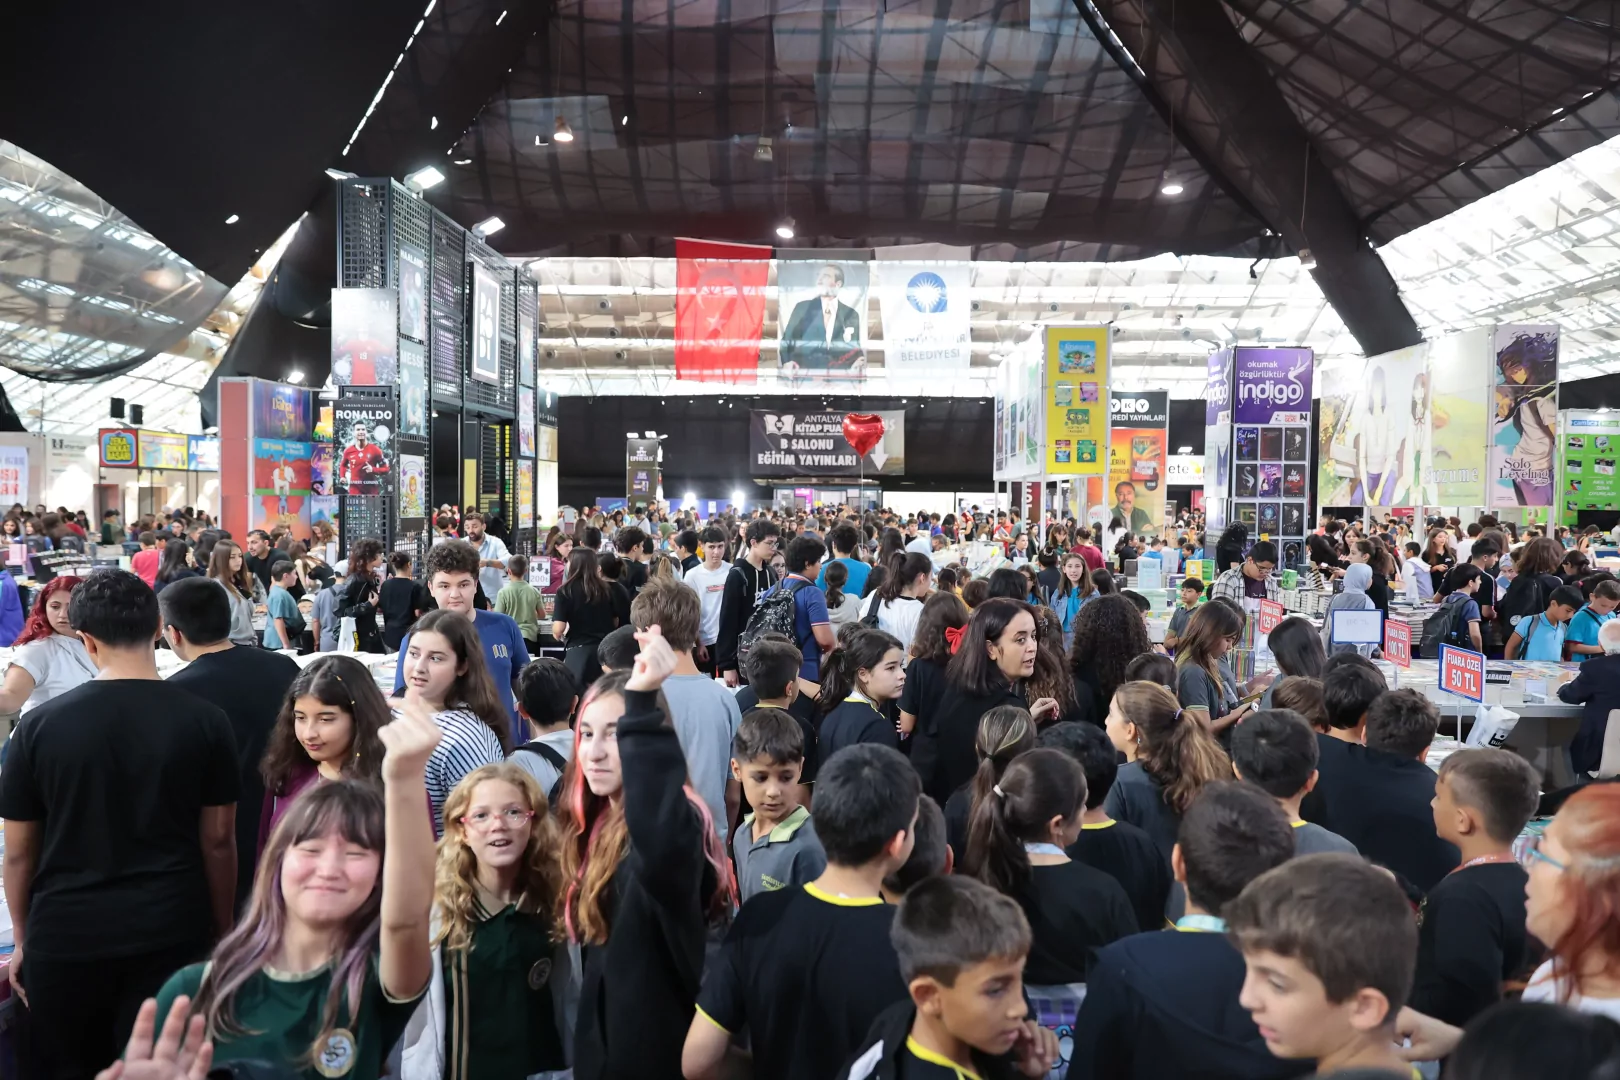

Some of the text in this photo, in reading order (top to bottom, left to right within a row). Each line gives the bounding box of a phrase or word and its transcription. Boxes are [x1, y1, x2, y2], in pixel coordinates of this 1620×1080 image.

[1247, 360, 1278, 368] okumak
[1239, 370, 1285, 379] özgürlüktür
[1239, 380, 1301, 404] indigo
[335, 410, 392, 419] RONALDO
[804, 415, 841, 423] ANTALYA
[1111, 413, 1128, 421] REDİ
[795, 423, 843, 432] KİTAP FUA
[780, 438, 834, 450] B SALONU
[757, 451, 856, 466] EĞİTİM YAYINLARI
[1503, 458, 1531, 469] Solo
[1499, 467, 1549, 481] Leveling
[1263, 615, 1271, 629] 125
[1387, 627, 1408, 641] FUARA ÖZEL
[1388, 640, 1406, 658] 100 TL
[1447, 653, 1482, 672] FUARA ÖZEL
[1451, 669, 1477, 692] 50 TL
